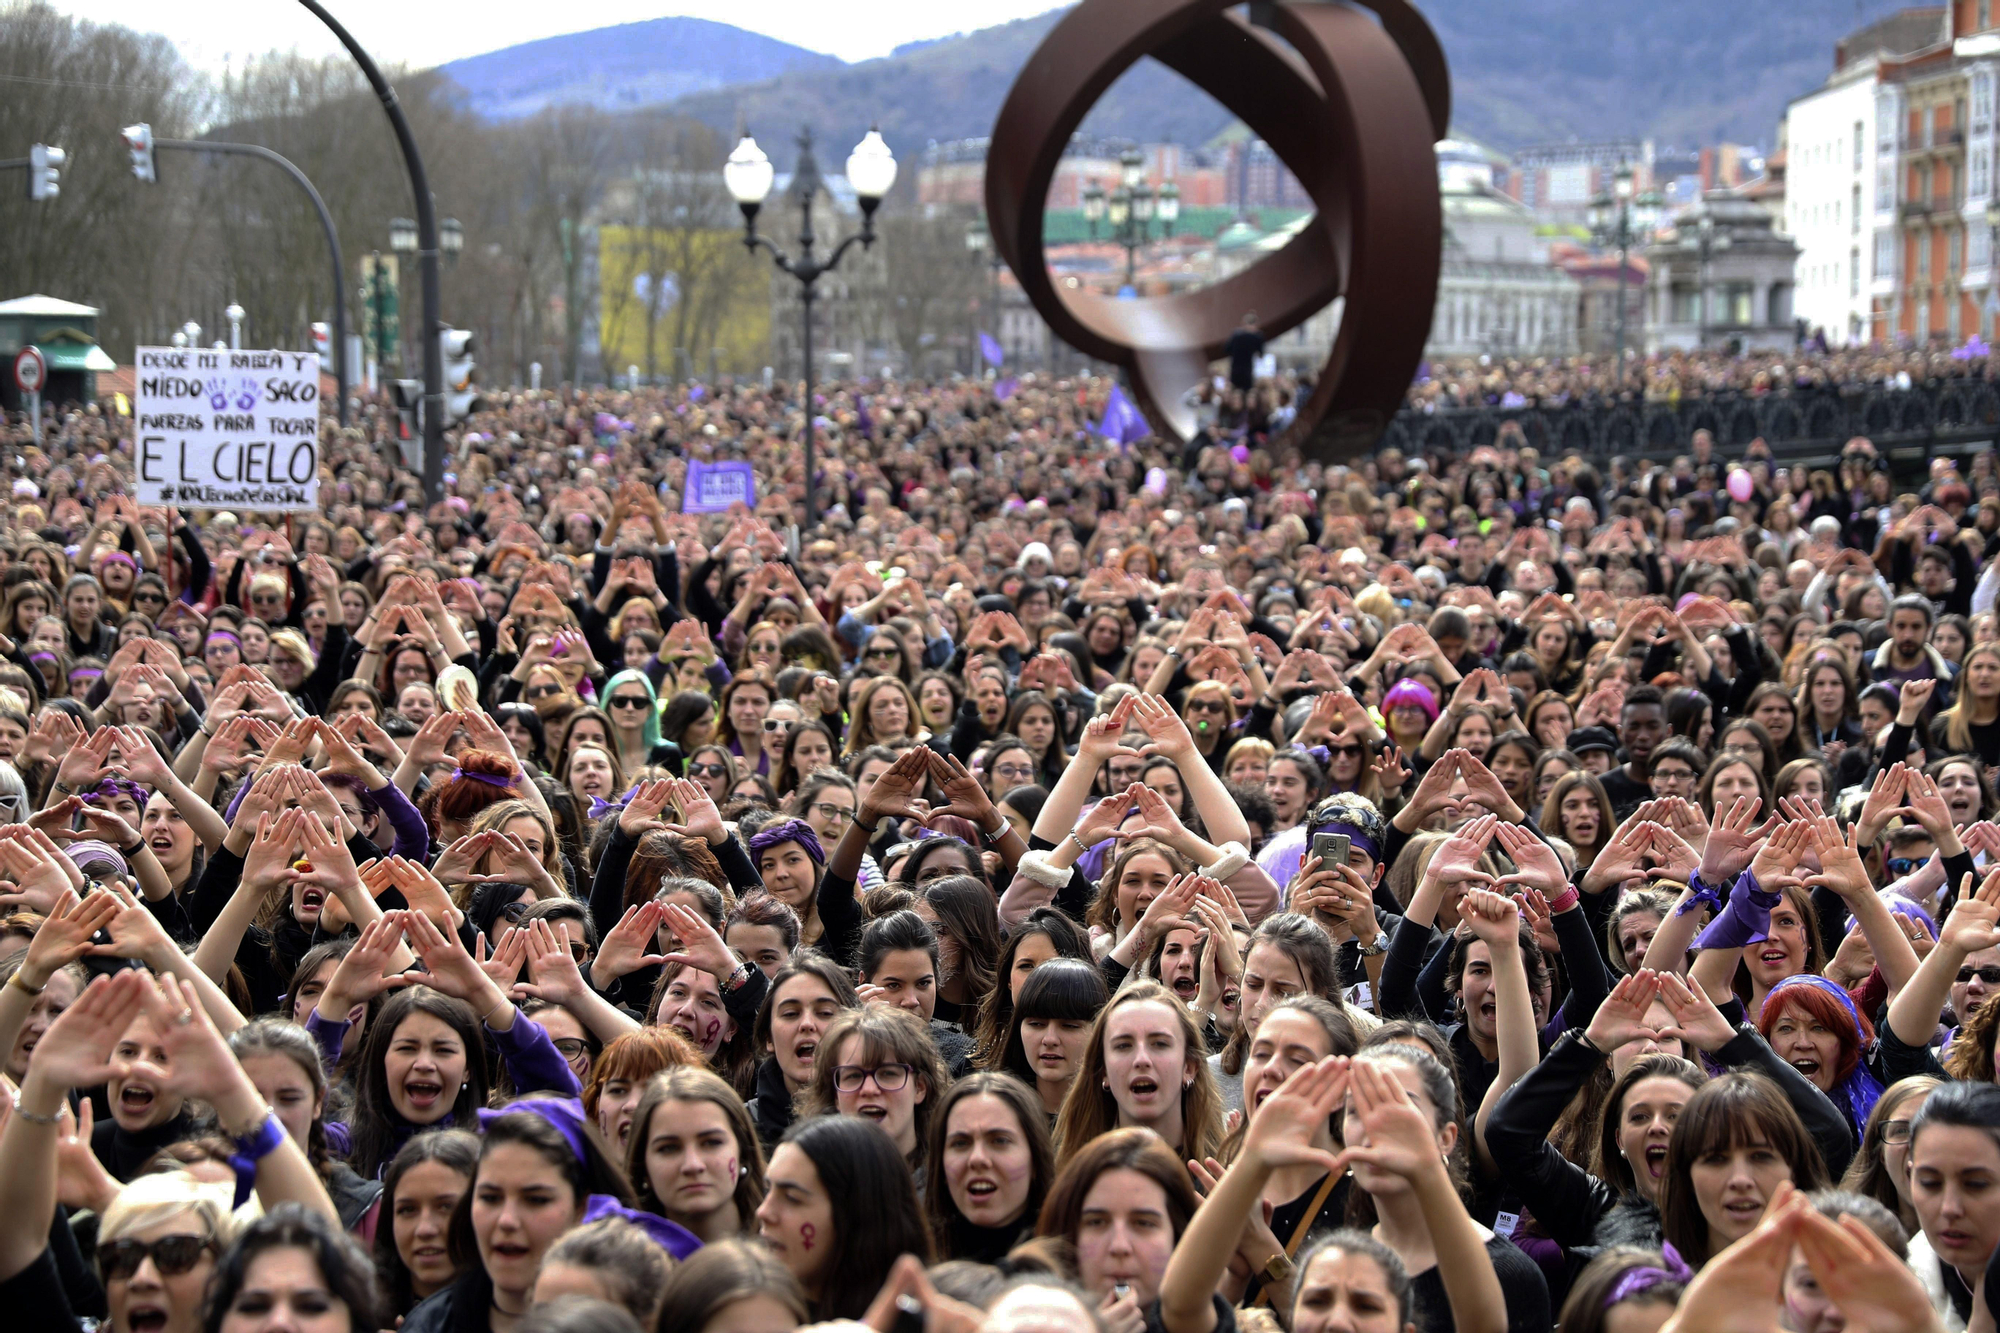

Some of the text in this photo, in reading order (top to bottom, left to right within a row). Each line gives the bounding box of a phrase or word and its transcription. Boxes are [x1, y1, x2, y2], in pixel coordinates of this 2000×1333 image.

[142, 353, 189, 368] DESDE
[230, 353, 283, 369] RABIA
[293, 355, 306, 371] Y
[265, 377, 317, 402] SACO
[141, 414, 316, 436] FUERZAS PARA TOCAR
[213, 440, 316, 484] CIELO
